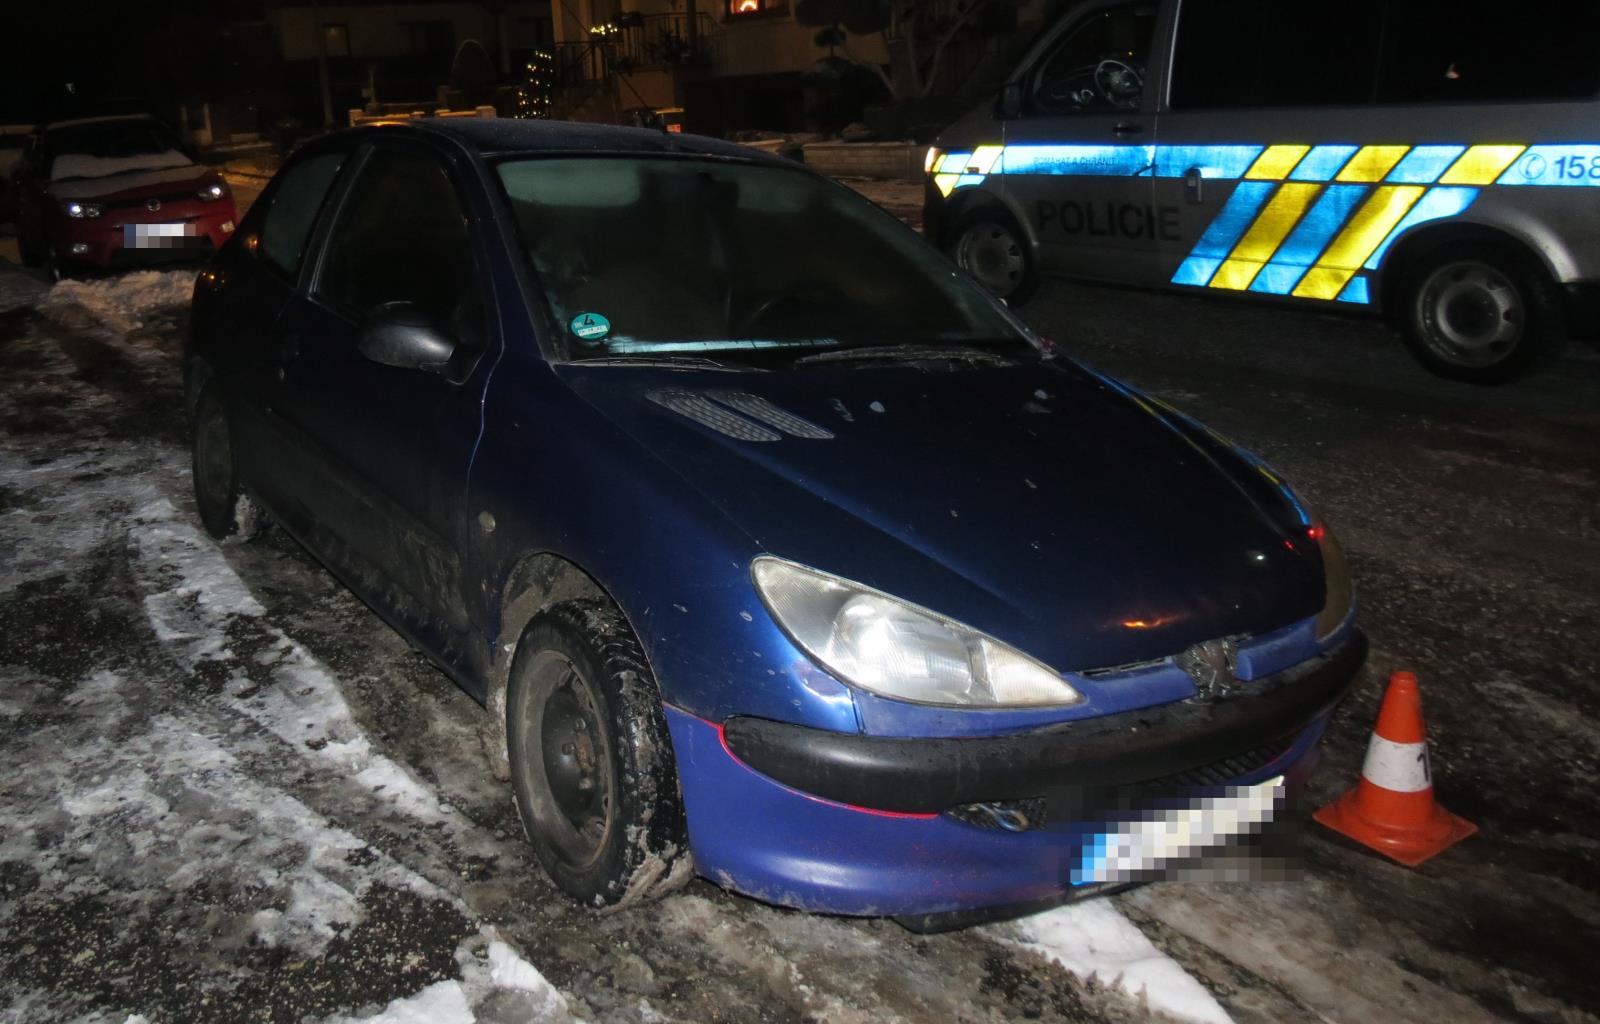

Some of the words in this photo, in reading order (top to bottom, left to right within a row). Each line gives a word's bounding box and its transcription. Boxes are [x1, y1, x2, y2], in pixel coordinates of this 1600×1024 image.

[1554, 155, 1600, 179] 158
[1038, 200, 1182, 241] POLICIE
[584, 315, 595, 325] 4
[1416, 752, 1429, 782] 1
